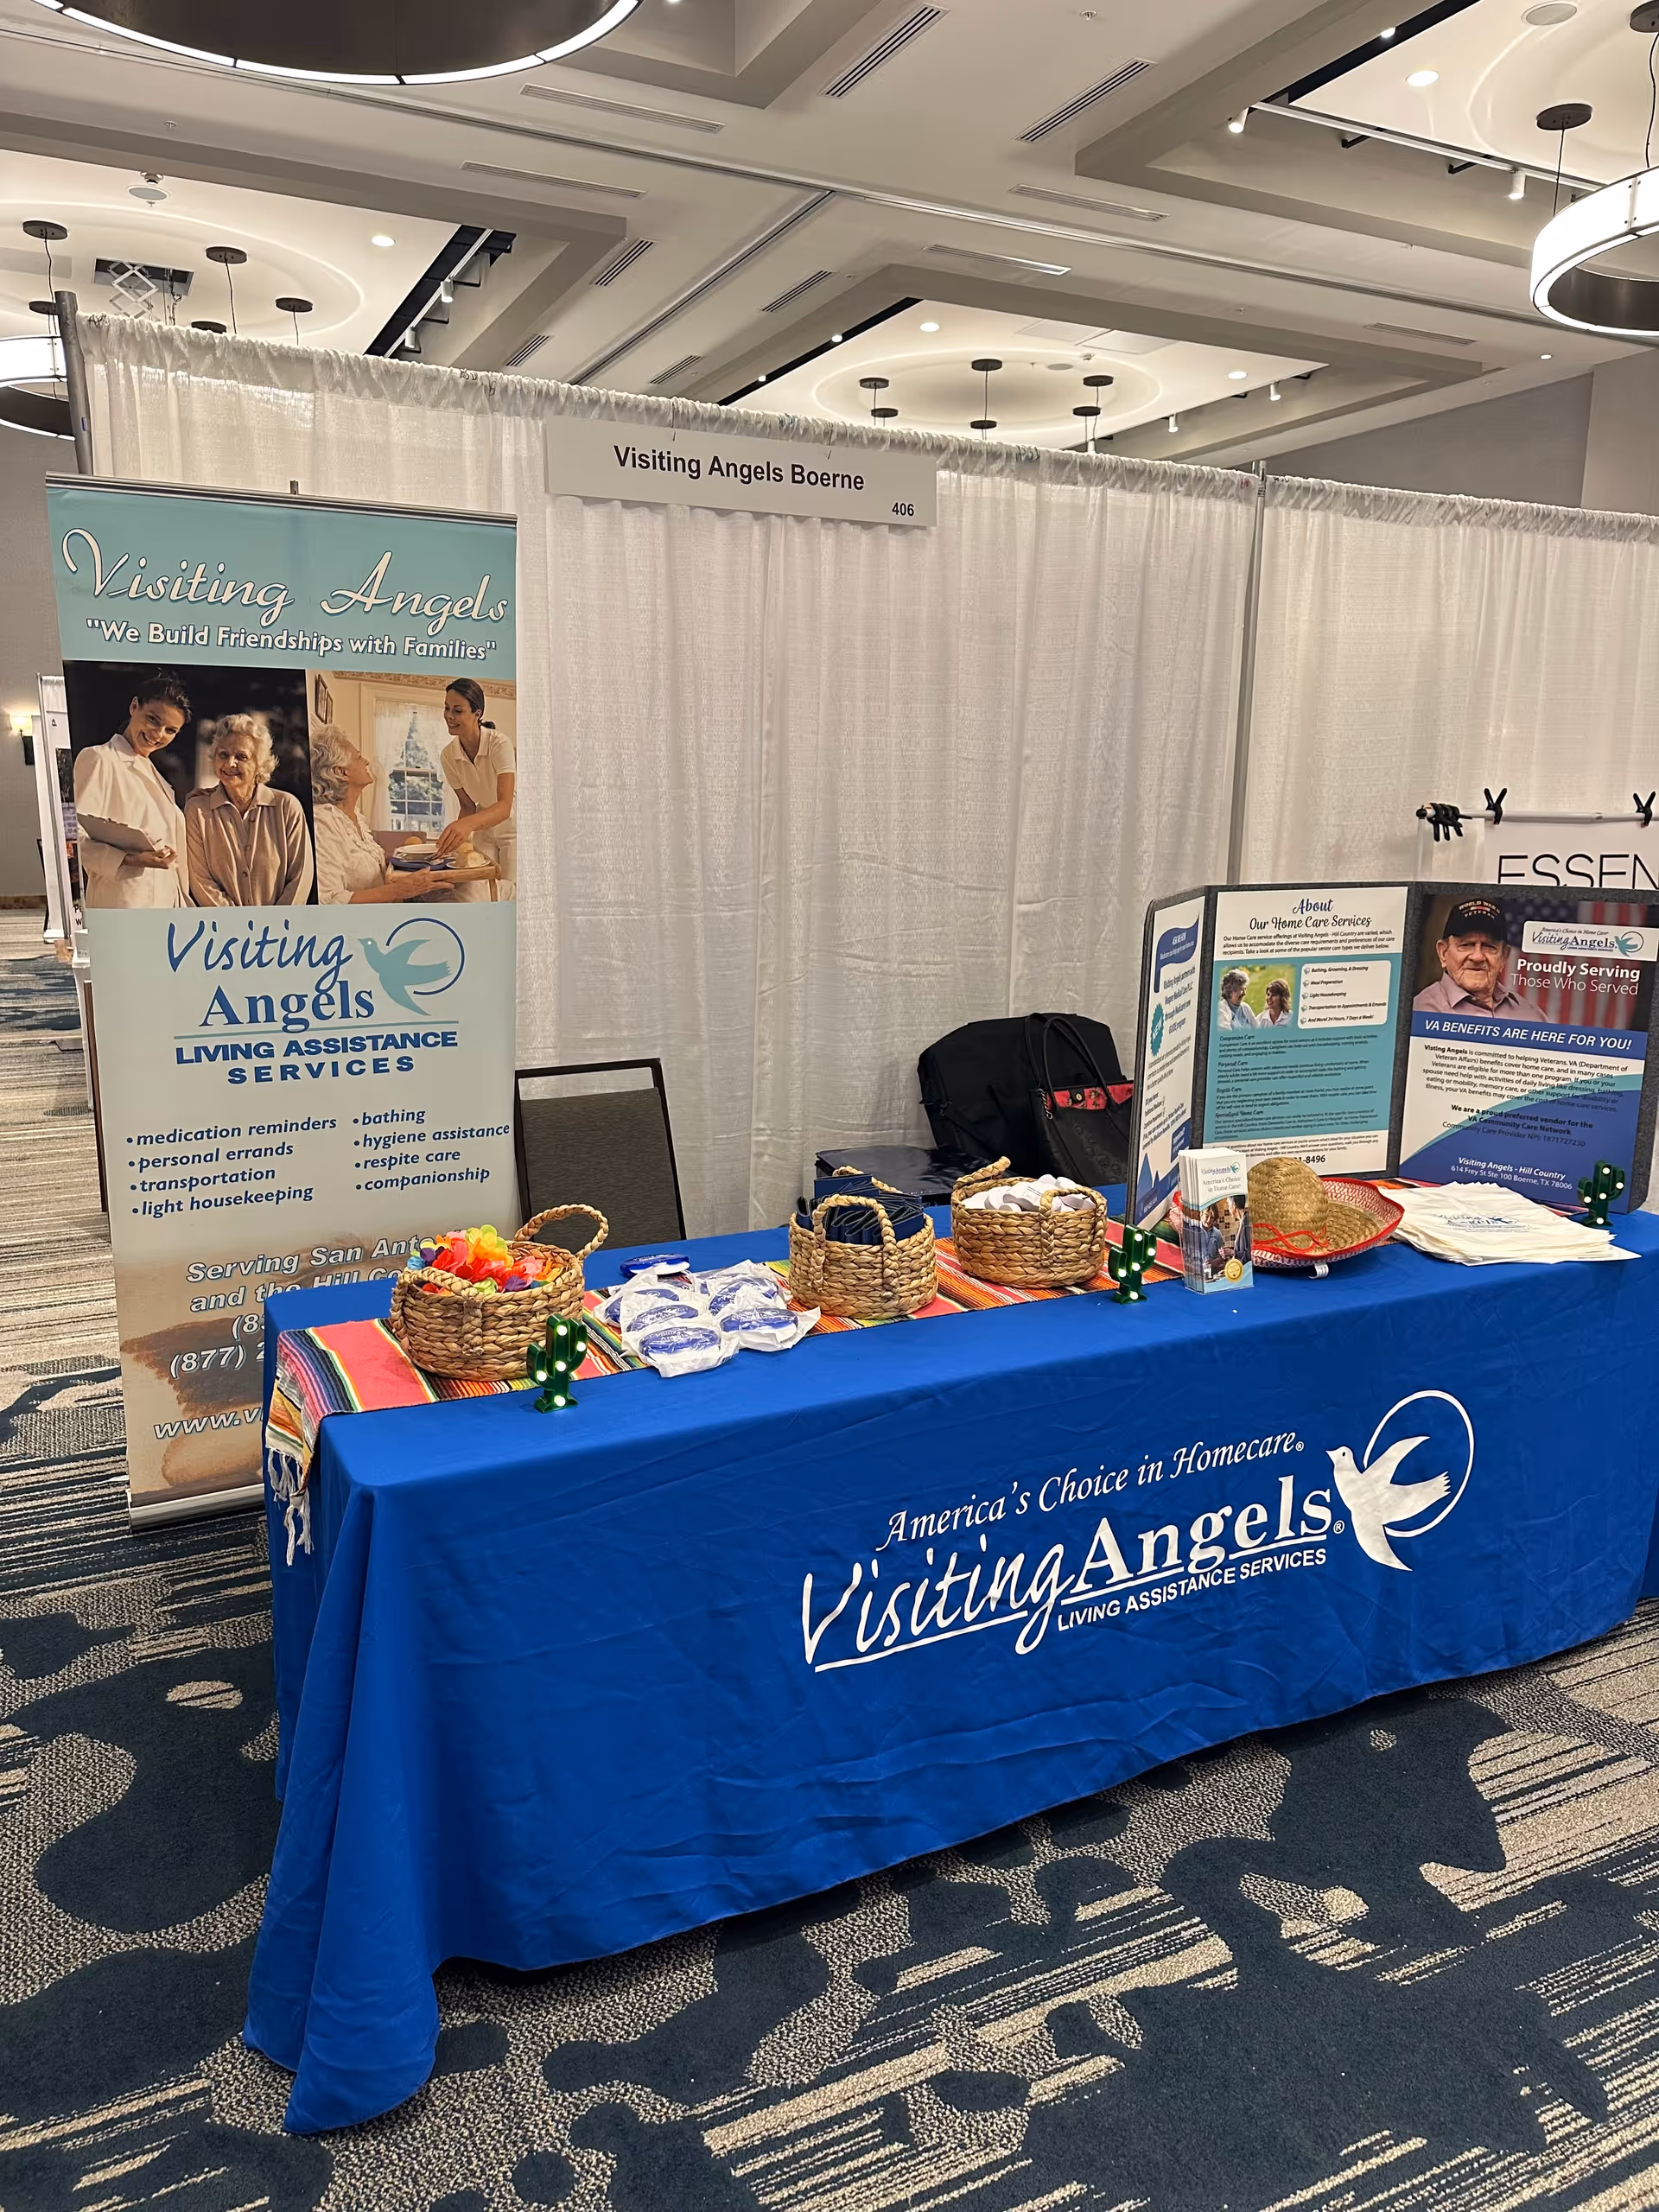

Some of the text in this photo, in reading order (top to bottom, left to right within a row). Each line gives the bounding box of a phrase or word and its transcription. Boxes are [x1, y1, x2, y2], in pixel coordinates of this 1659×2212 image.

[613, 445, 865, 490] Visiting Angels Boerne
[892, 502, 915, 517] 406
[61, 528, 508, 636] Visiting Angels
[86, 618, 497, 660] "We Build Friendships with Families"
[1292, 899, 1333, 914] About
[1459, 900, 1482, 910] WORLD
[1483, 901, 1496, 910] WAR
[1465, 910, 1495, 919] VETERAN
[1249, 914, 1372, 931] Our Home Care Services
[1532, 931, 1570, 950] Visiting
[167, 919, 353, 993] Visiting
[1517, 958, 1640, 982] Proudly Serving
[1510, 973, 1639, 995] Those Who Served
[198, 980, 375, 1033] Angels
[1425, 1020, 1632, 1050] VA BENEFITS ARE HERE FOR YOU!
[175, 1031, 458, 1065] LIVING ASSISTANCE
[1474, 1050, 1507, 1058] committed
[1516, 1054, 1539, 1064] helping
[1579, 1061, 1619, 1071] (Department
[227, 1055, 414, 1084] SERVICES
[1479, 1058, 1503, 1067] benefits
[361, 1109, 426, 1125] bathing
[1478, 1116, 1521, 1129] Community
[1521, 1122, 1538, 1131] Care
[1539, 1125, 1571, 1135] Network
[1503, 1112, 1538, 1122] preferred
[1540, 1116, 1567, 1125] vendor
[137, 1117, 337, 1145] medication reminders
[362, 1124, 510, 1150] hygiene assistance
[1442, 1122, 1481, 1134] Community
[1498, 1128, 1527, 1139] Provider
[1543, 1135, 1586, 1147] 1871727230
[138, 1141, 294, 1173] personal errands
[363, 1151, 461, 1170] respite care
[1459, 1157, 1486, 1169] Visiting
[1486, 1161, 1513, 1172] Angels
[1518, 1166, 1533, 1175] Hill
[1533, 1168, 1566, 1181] Country
[140, 1167, 276, 1192] transportation
[364, 1167, 490, 1190] companionship
[1464, 1166, 1479, 1176] Frey
[1513, 1175, 1539, 1185] Boerne,
[1550, 1180, 1573, 1190] 78006
[142, 1186, 314, 1218] light housekeeping
[186, 1234, 435, 1282] Serving San Ant
[190, 1285, 246, 1312] and
[169, 1344, 246, 1380] (877)
[153, 1406, 263, 1440] www.v
[875, 1481, 1031, 1552] America's
[1038, 1465, 1129, 1513] Choice
[1137, 1454, 1163, 1486] in
[801, 1534, 1076, 1665] Visiting
[1057, 1548, 1327, 1632] LIVING ASSISTANCE SERVICES
